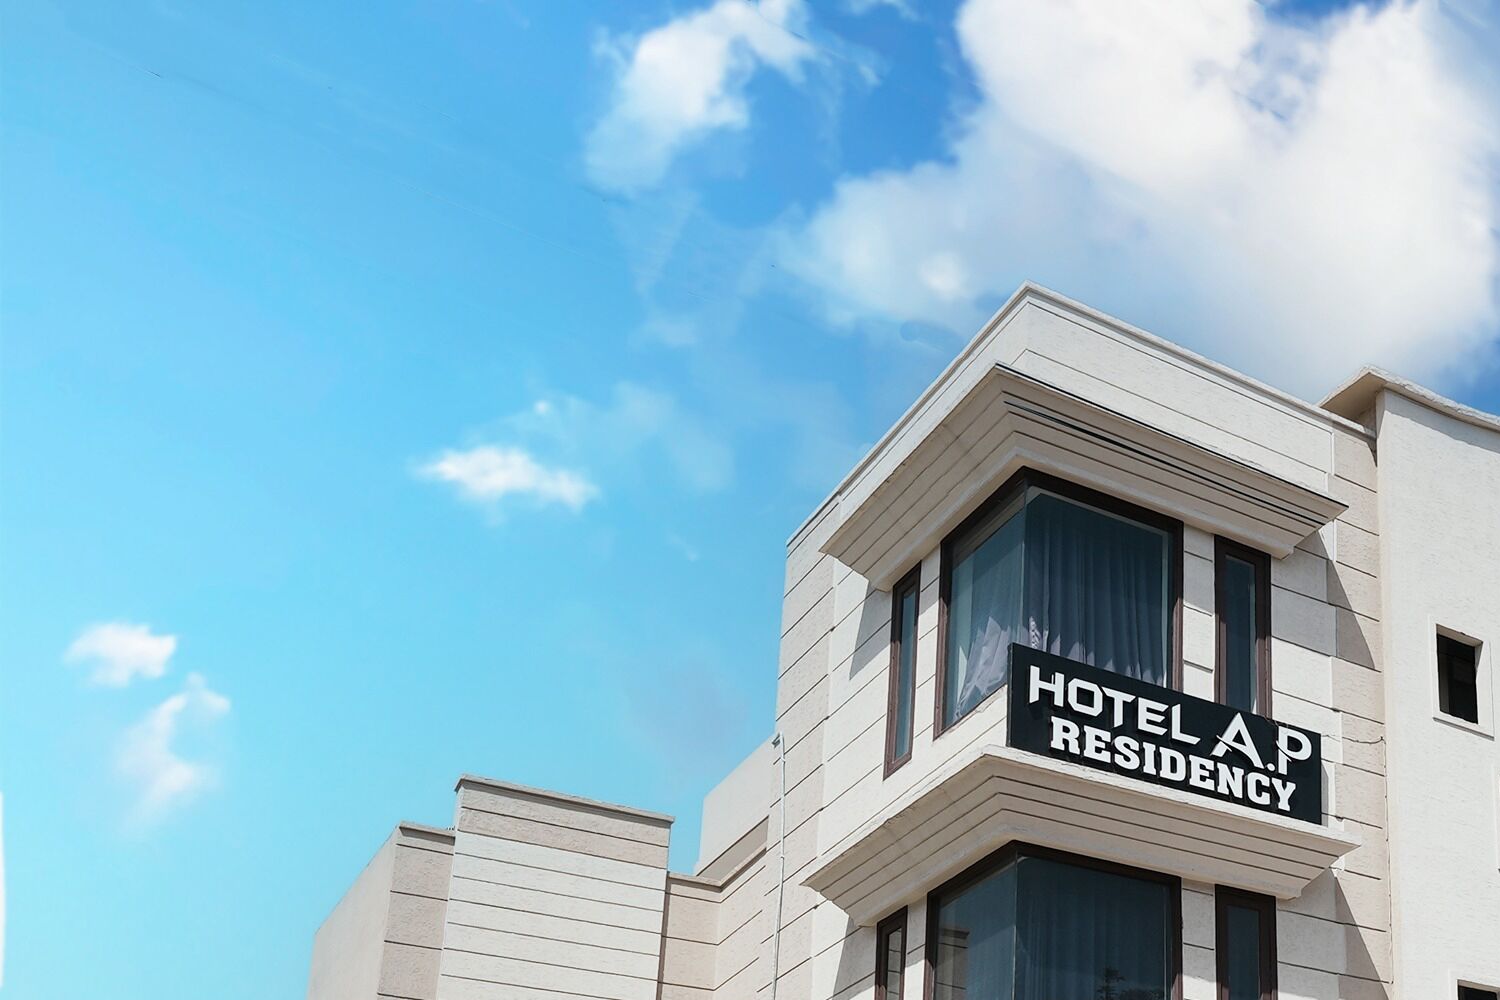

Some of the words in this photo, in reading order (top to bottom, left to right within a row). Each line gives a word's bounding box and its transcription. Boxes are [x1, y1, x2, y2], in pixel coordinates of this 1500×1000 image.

[1029, 665, 1200, 745] HOTEL
[1210, 712, 1312, 775] A.P
[1050, 716, 1296, 811] RESIDENCY
